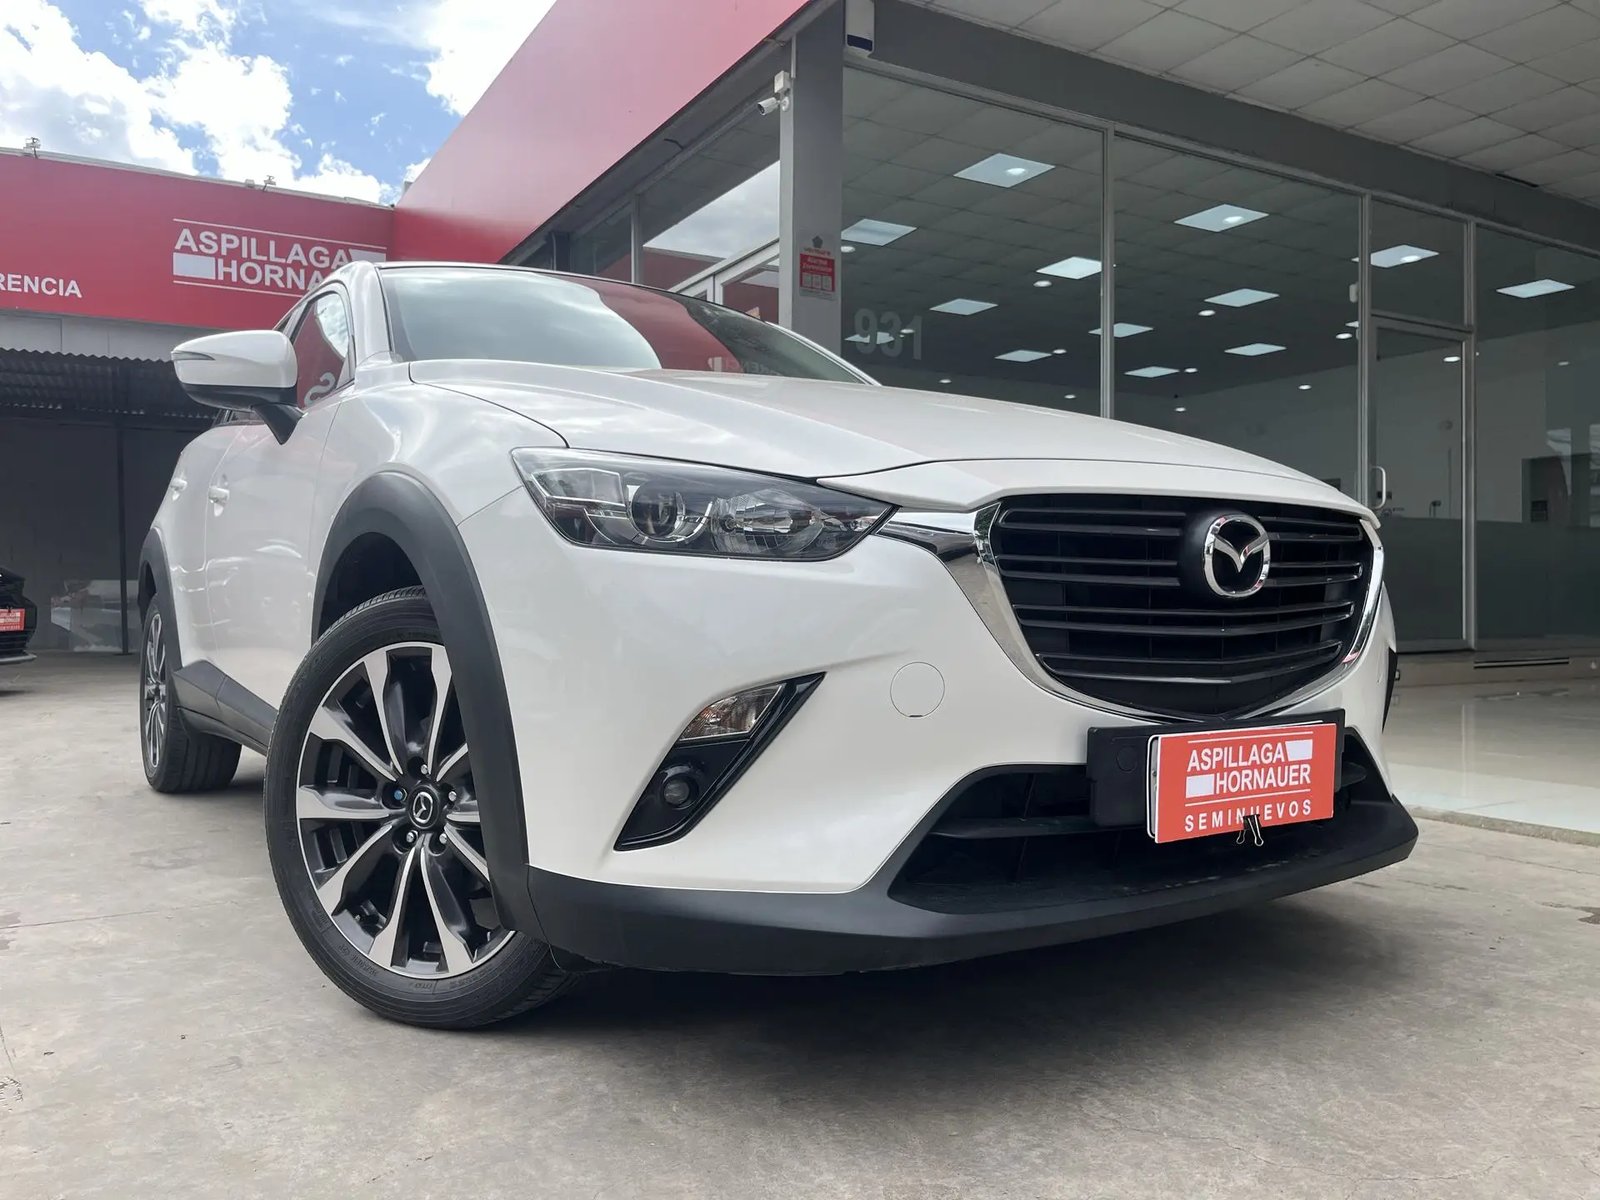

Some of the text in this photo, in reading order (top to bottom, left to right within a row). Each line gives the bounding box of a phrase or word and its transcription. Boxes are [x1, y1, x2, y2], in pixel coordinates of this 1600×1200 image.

[174, 228, 353, 270] ASPILLAGA
[854, 308, 922, 361] 931
[1186, 741, 1286, 773] ASPILLAGA
[1215, 763, 1311, 795] HORNAUER
